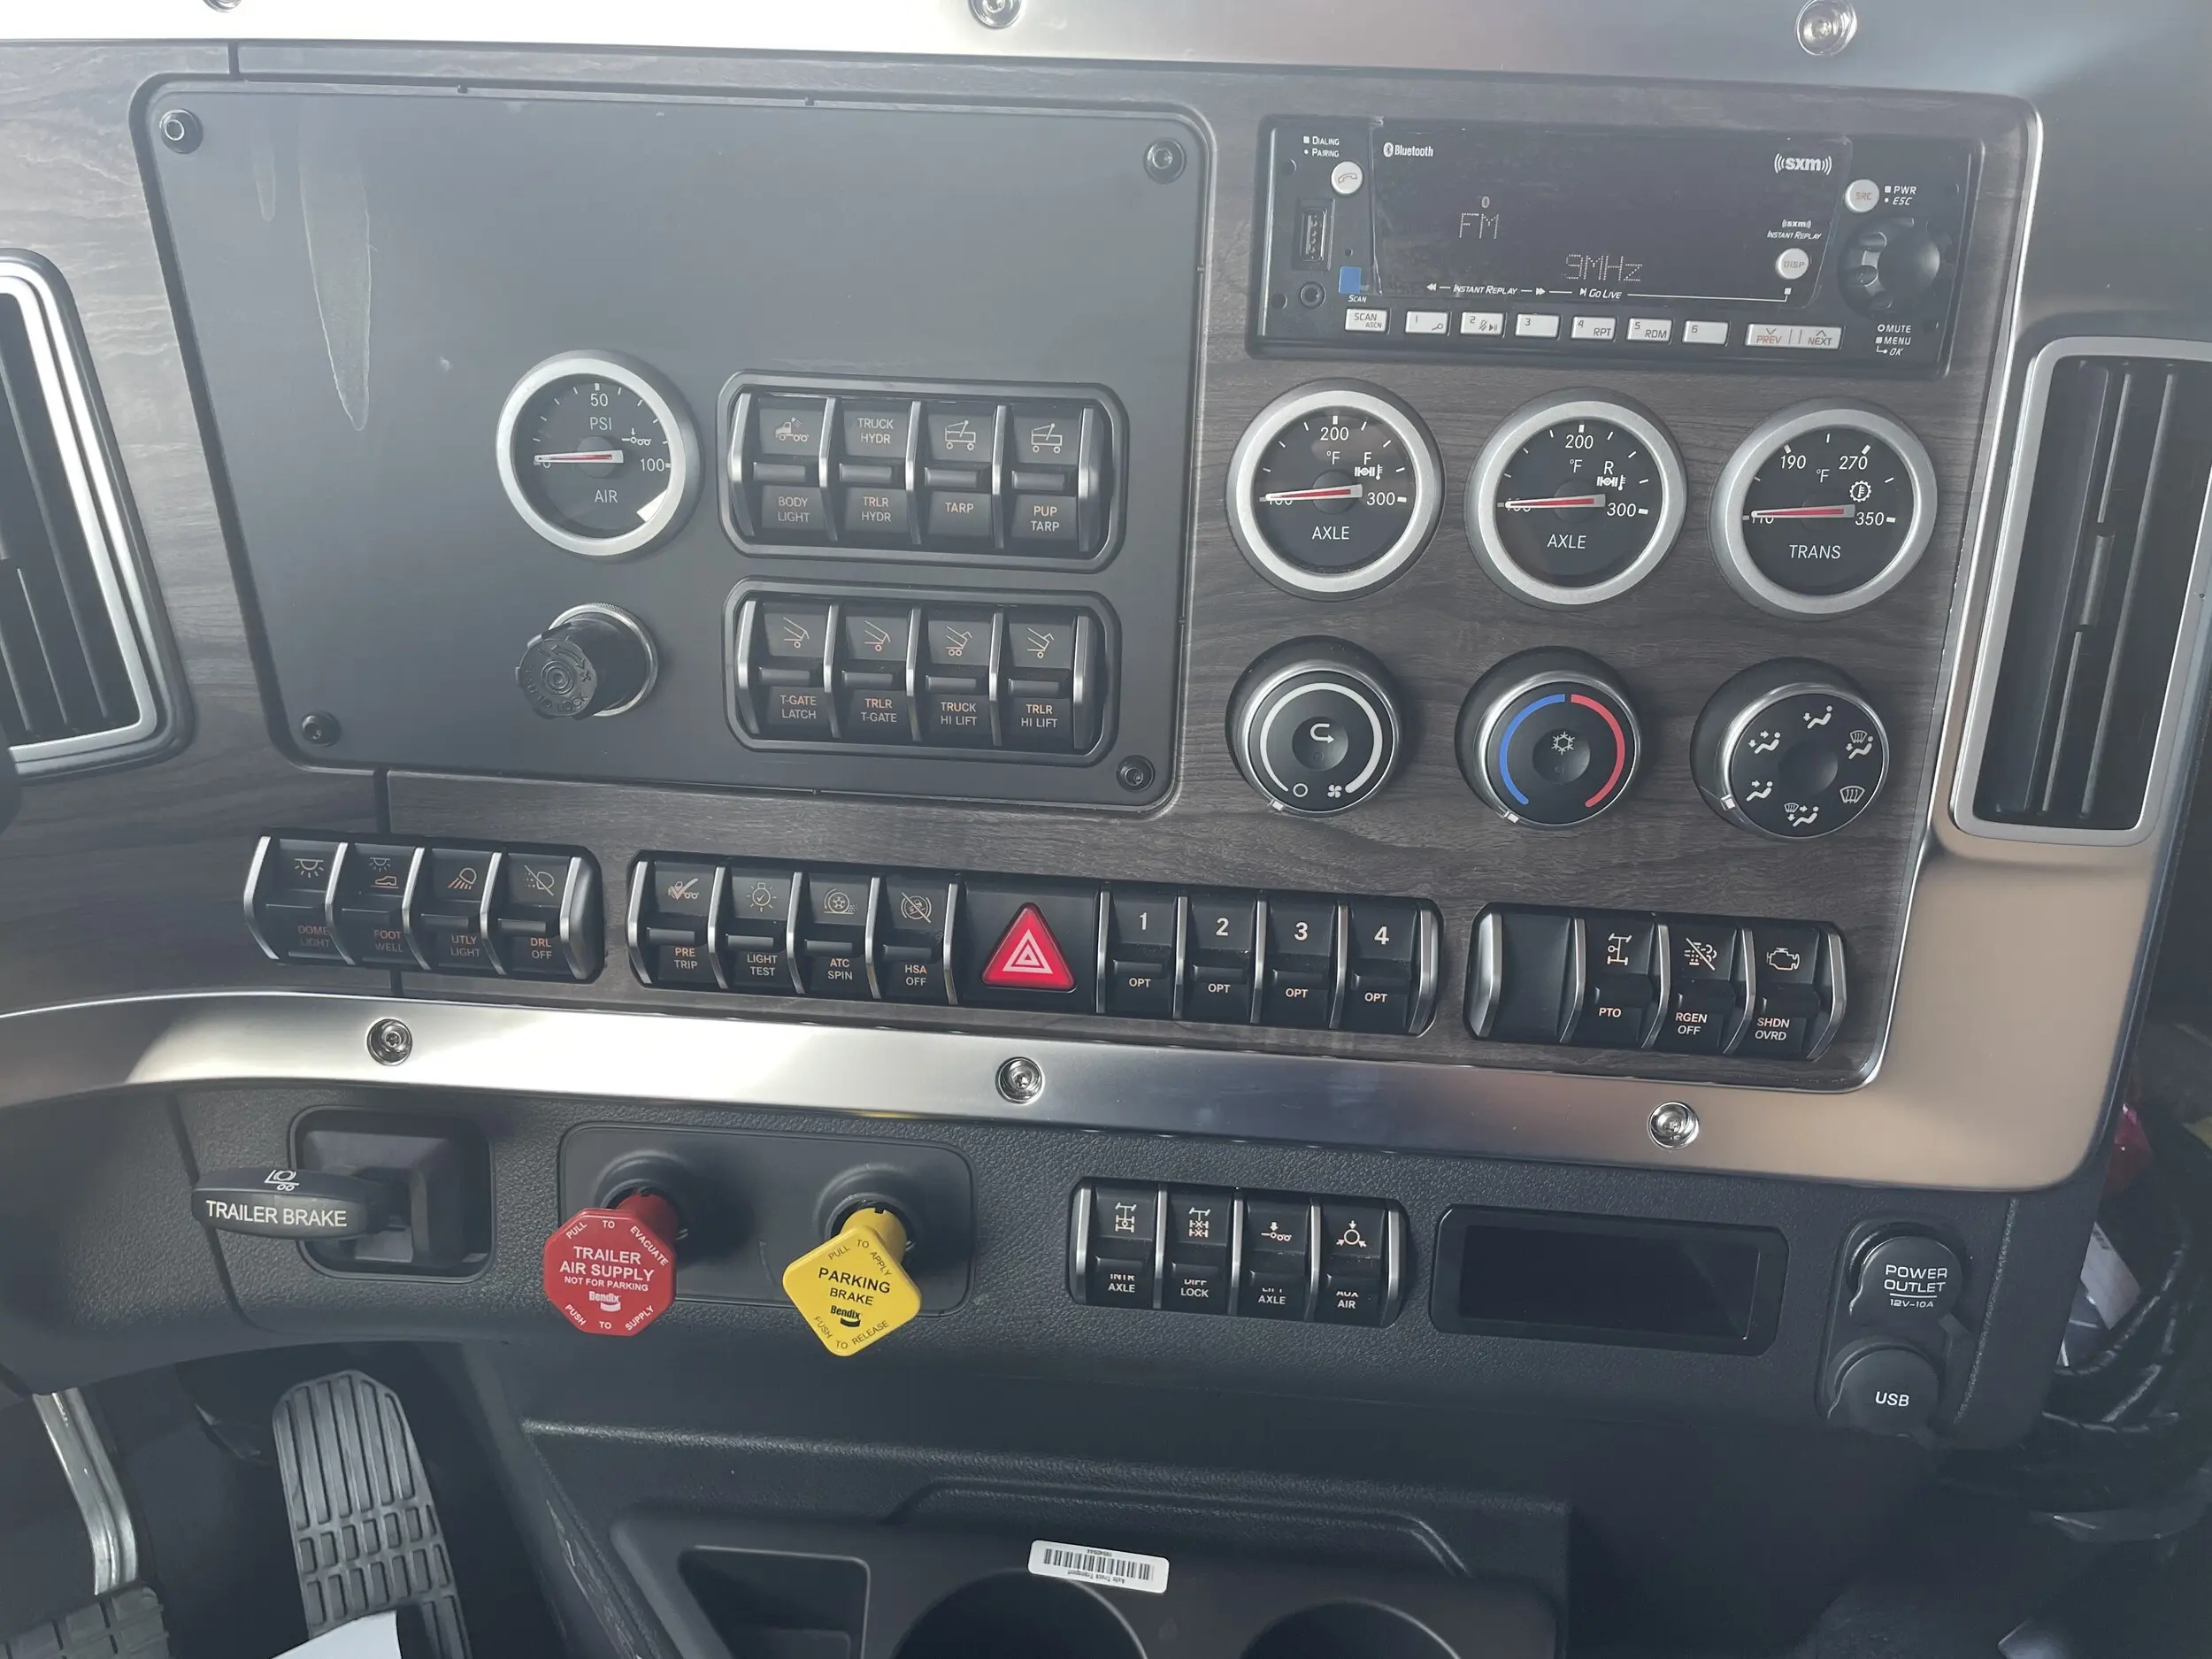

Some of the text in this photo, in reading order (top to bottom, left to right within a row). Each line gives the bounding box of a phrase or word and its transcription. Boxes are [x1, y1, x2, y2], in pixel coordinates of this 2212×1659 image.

[1394, 145, 1433, 157] Bluetooth
[1893, 186, 1916, 195] PWR
[1855, 192, 1872, 201] SRC
[1893, 196, 1912, 205] ESC
[1459, 213, 1499, 239] FM
[1784, 260, 1805, 269] DISP
[1354, 312, 1377, 321] SCAN
[1525, 318, 1531, 326] 3
[1594, 327, 1612, 337] RPT
[1645, 329, 1667, 338] RDM
[1886, 324, 1911, 334] MUTE
[1755, 335, 1782, 344] PREV
[1808, 337, 1832, 346] NEXT
[1884, 336, 1911, 346] MENU
[1889, 347, 1903, 356] OK
[590, 394, 609, 407] 50
[589, 417, 611, 430] PSI
[857, 418, 895, 430] TRUCK
[861, 434, 891, 444] HYDR
[1320, 427, 1349, 441] 200
[1565, 434, 1594, 449] 200
[1363, 452, 1371, 465] F
[1780, 455, 1807, 470] 190
[1839, 455, 1868, 470] 270
[640, 458, 664, 472] 100
[1603, 461, 1615, 475] R
[594, 490, 618, 503] AIR
[778, 496, 809, 507] BODY
[863, 496, 888, 507] TRLR
[1366, 492, 1394, 506] 300
[945, 503, 973, 513] TARP
[1033, 506, 1057, 517] PUP
[1606, 503, 1636, 517] 300
[778, 511, 810, 523] LIGHT
[862, 511, 891, 522] HYDR
[1855, 512, 1885, 526] 350
[1031, 520, 1060, 532] TARP
[1311, 526, 1350, 540] AXLE
[1547, 534, 1586, 549] AXLE
[1789, 544, 1841, 559] TRANS
[780, 695, 817, 706] T-GATE
[865, 698, 892, 709] TRLR
[941, 702, 977, 712] TRUCK
[1026, 704, 1053, 715] TRLR
[782, 709, 817, 719] LATCH
[861, 712, 897, 723] T-GATE
[941, 716, 977, 726] HI LIFT
[1022, 718, 1057, 728] HI LIFT
[1139, 912, 1148, 931] 1
[1216, 918, 1230, 936] 2
[298, 926, 328, 935] DOME
[374, 929, 402, 940] FOOT
[1294, 922, 1309, 941] 3
[1373, 926, 1389, 945] 4
[300, 937, 330, 948] LIGHT
[451, 935, 477, 945] UTLY
[531, 938, 551, 948] DRL
[374, 941, 403, 952] WELL
[450, 947, 481, 958] LIGHT
[532, 949, 553, 960] OFF
[675, 948, 695, 957] PRE
[674, 959, 698, 970] TRIP
[747, 954, 778, 964] LIGHT
[830, 957, 850, 968] ATC
[750, 966, 776, 977] TEST
[904, 964, 927, 974] HSA
[827, 970, 853, 980] SPIN
[905, 976, 927, 987] OFF
[1129, 978, 1151, 988] OPT
[1208, 983, 1230, 994] OPT
[1286, 988, 1309, 998] OPT
[1364, 992, 1387, 1002] OPT
[1598, 1007, 1622, 1018] PTO
[1676, 1012, 1708, 1023] RGEN
[1757, 1018, 1790, 1028] SHDN
[1678, 1025, 1701, 1035] OFF
[1755, 1030, 1787, 1041] OVRD
[205, 1200, 348, 1227] TRAILER BRAKE
[565, 1222, 588, 1239] PULL
[630, 1225, 669, 1266] EVACUATE
[573, 1246, 641, 1264] TRAILER
[828, 1239, 892, 1276] PULL TO APPLY
[560, 1261, 655, 1281] AIR SUPPLY
[1886, 1264, 1947, 1279] POWER
[565, 1276, 583, 1285] NOT
[607, 1280, 649, 1292] PARKING
[818, 1267, 890, 1294] PARKING
[1884, 1279, 1946, 1293] OUTLET
[1108, 1283, 1136, 1293] AXLE
[1180, 1287, 1209, 1298] LOCK
[589, 1291, 619, 1302] Bendix
[830, 1287, 874, 1306] BRAKE
[1257, 1294, 1286, 1305] AXLE
[1338, 1299, 1356, 1309] AIR
[1890, 1299, 1934, 1308] 12V-10A
[565, 1304, 587, 1325] PUSH
[626, 1305, 655, 1331] SUPPLY
[831, 1305, 860, 1319] Bendix
[836, 1340, 848, 1349] TO
[851, 1320, 889, 1345] RELEASE
[1875, 1391, 1909, 1406] USB
